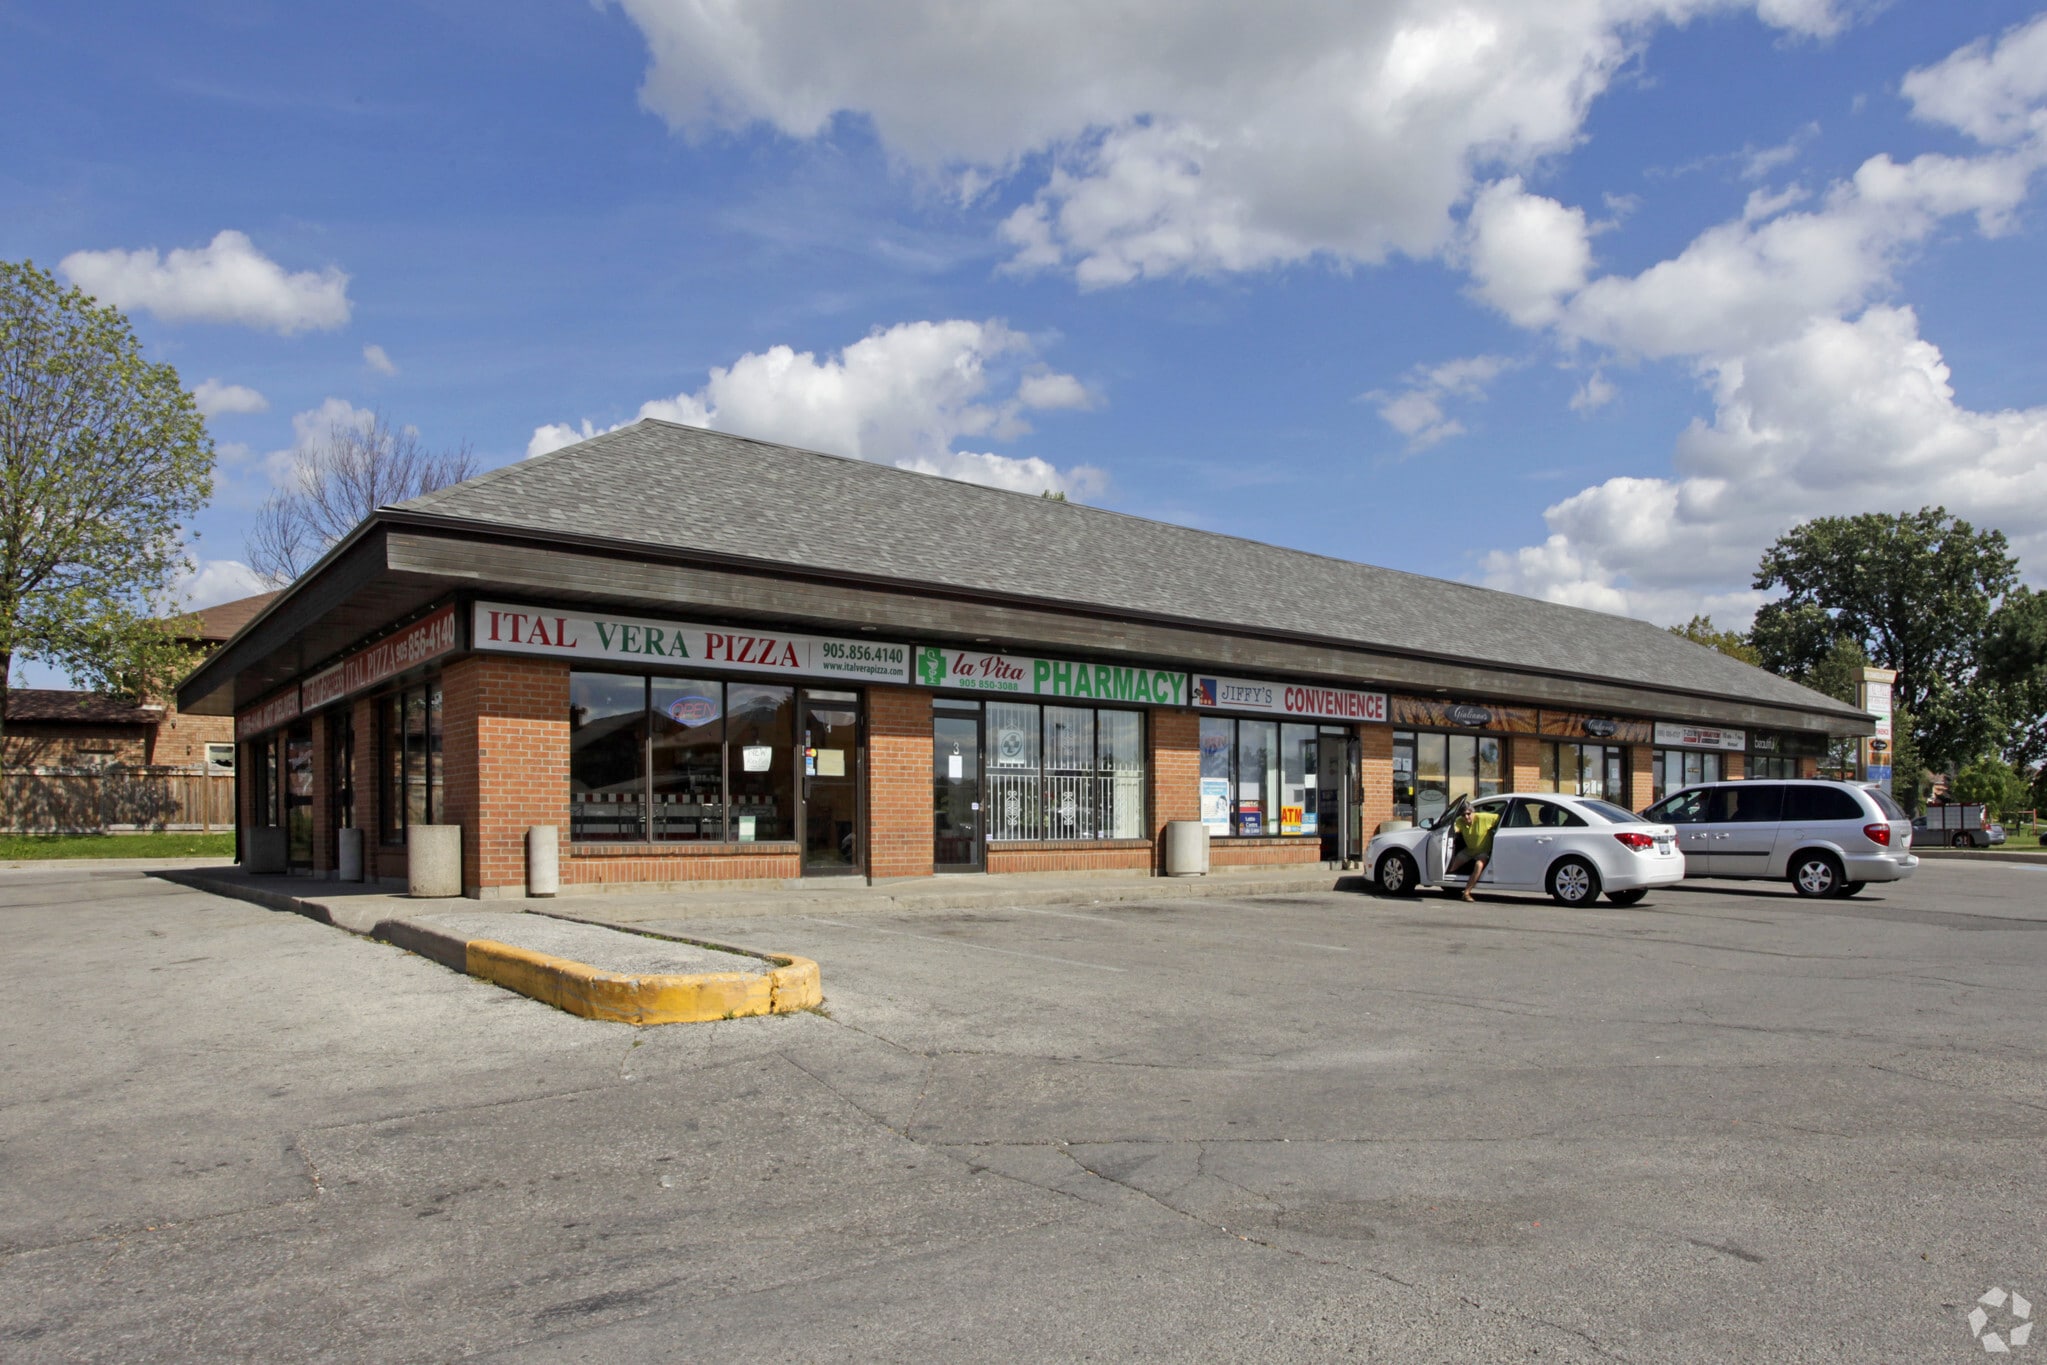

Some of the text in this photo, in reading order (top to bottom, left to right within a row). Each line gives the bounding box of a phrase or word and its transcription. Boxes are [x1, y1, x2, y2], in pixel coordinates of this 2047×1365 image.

[488, 610, 800, 668] ITAL VERA PIZZA
[345, 612, 455, 690] ITAL PIZZA 905 856-4140
[823, 642, 903, 664] 905.856.4140
[823, 661, 904, 677] www.italverapizza.com
[952, 652, 1186, 704] la Vita PHARMACY
[959, 678, 1018, 691] 905 850-3088
[671, 702, 718, 719] OPEN
[1221, 685, 1383, 719] JIFFY'S CONVENIENCE
[952, 742, 960, 755] 3
[1281, 808, 1302, 823] ATM
